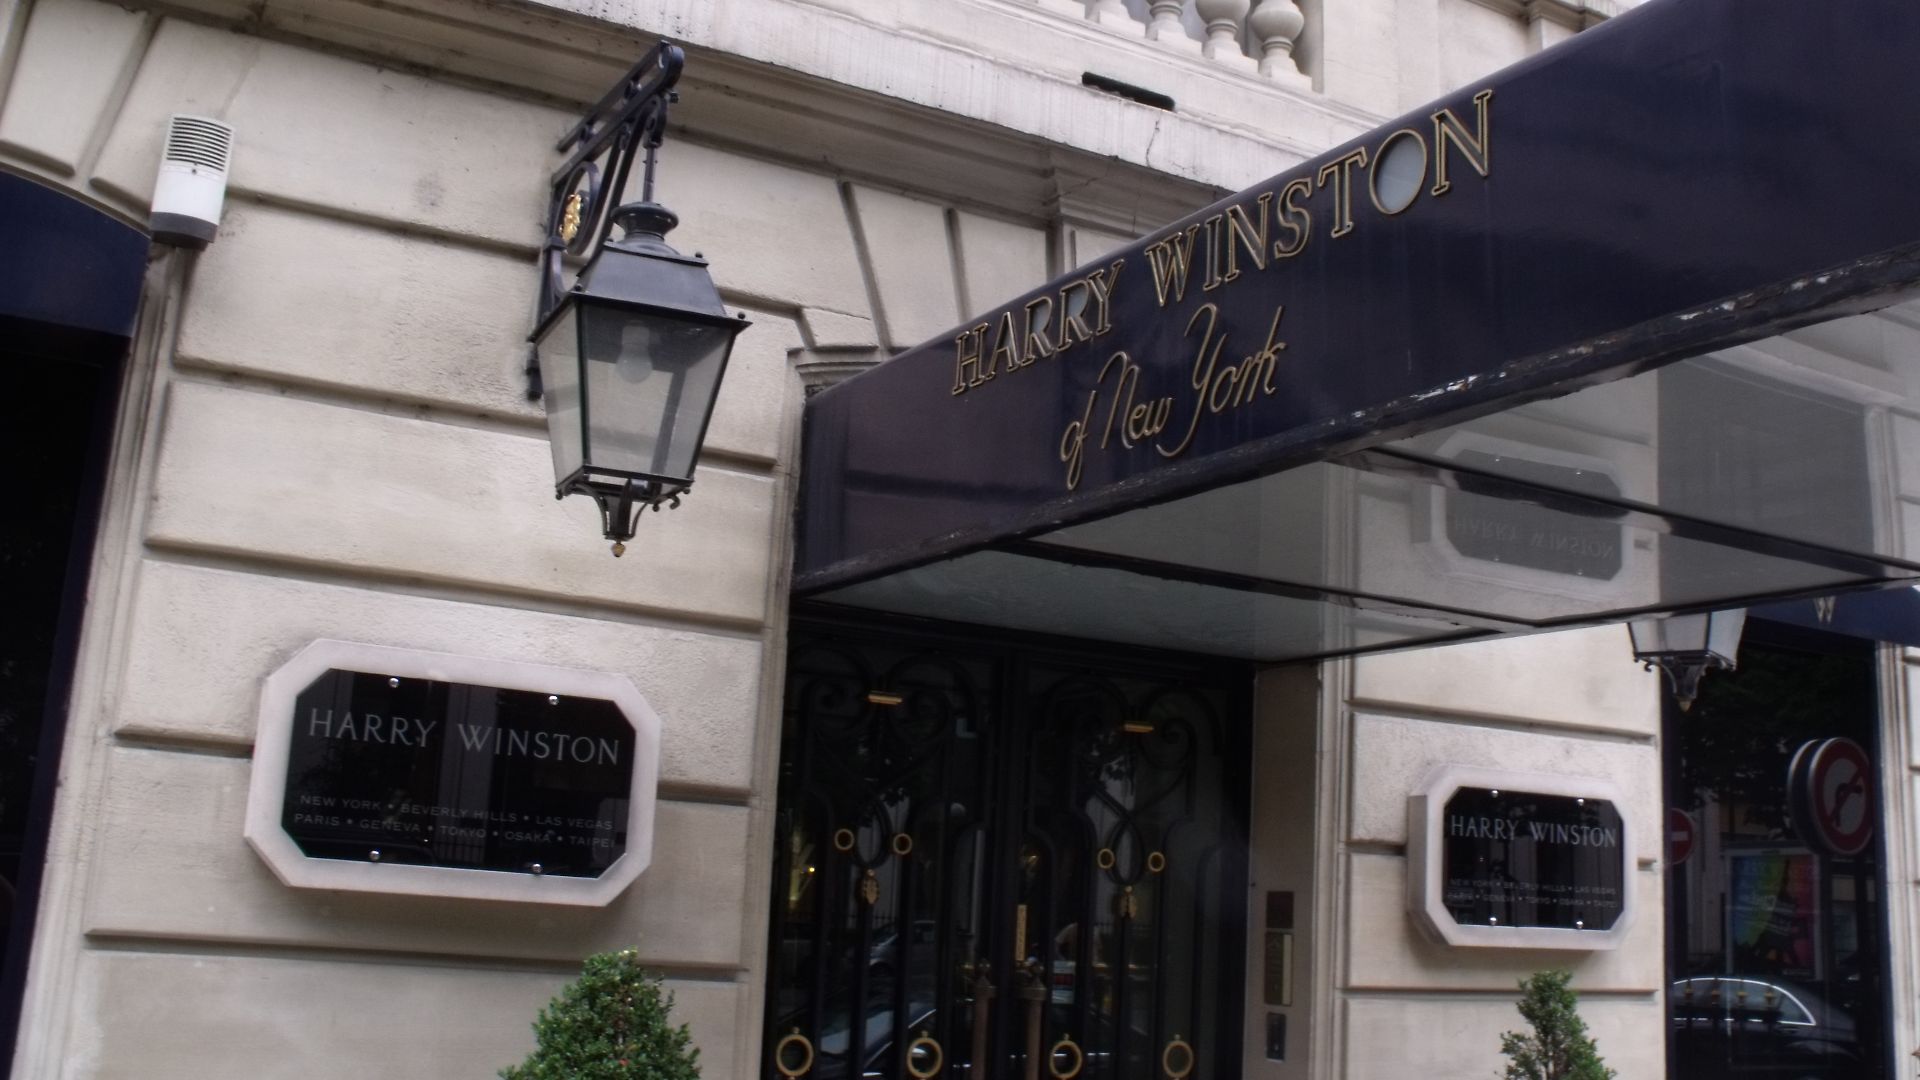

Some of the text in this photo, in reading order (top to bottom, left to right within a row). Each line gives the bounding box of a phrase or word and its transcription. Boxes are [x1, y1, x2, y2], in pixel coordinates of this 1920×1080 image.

[952, 89, 1494, 395] HARRY WINSTON
[1060, 303, 1287, 491] of New York
[308, 707, 620, 766] HARRY WINSTON
[293, 812, 615, 849] PARIS GENEVA TOKYO OSAKA TAIPEI
[299, 794, 613, 831] NEW YORK BEVERLY HILLS LAS VEGAS
[1450, 814, 1617, 849] HARRY WINSTON
